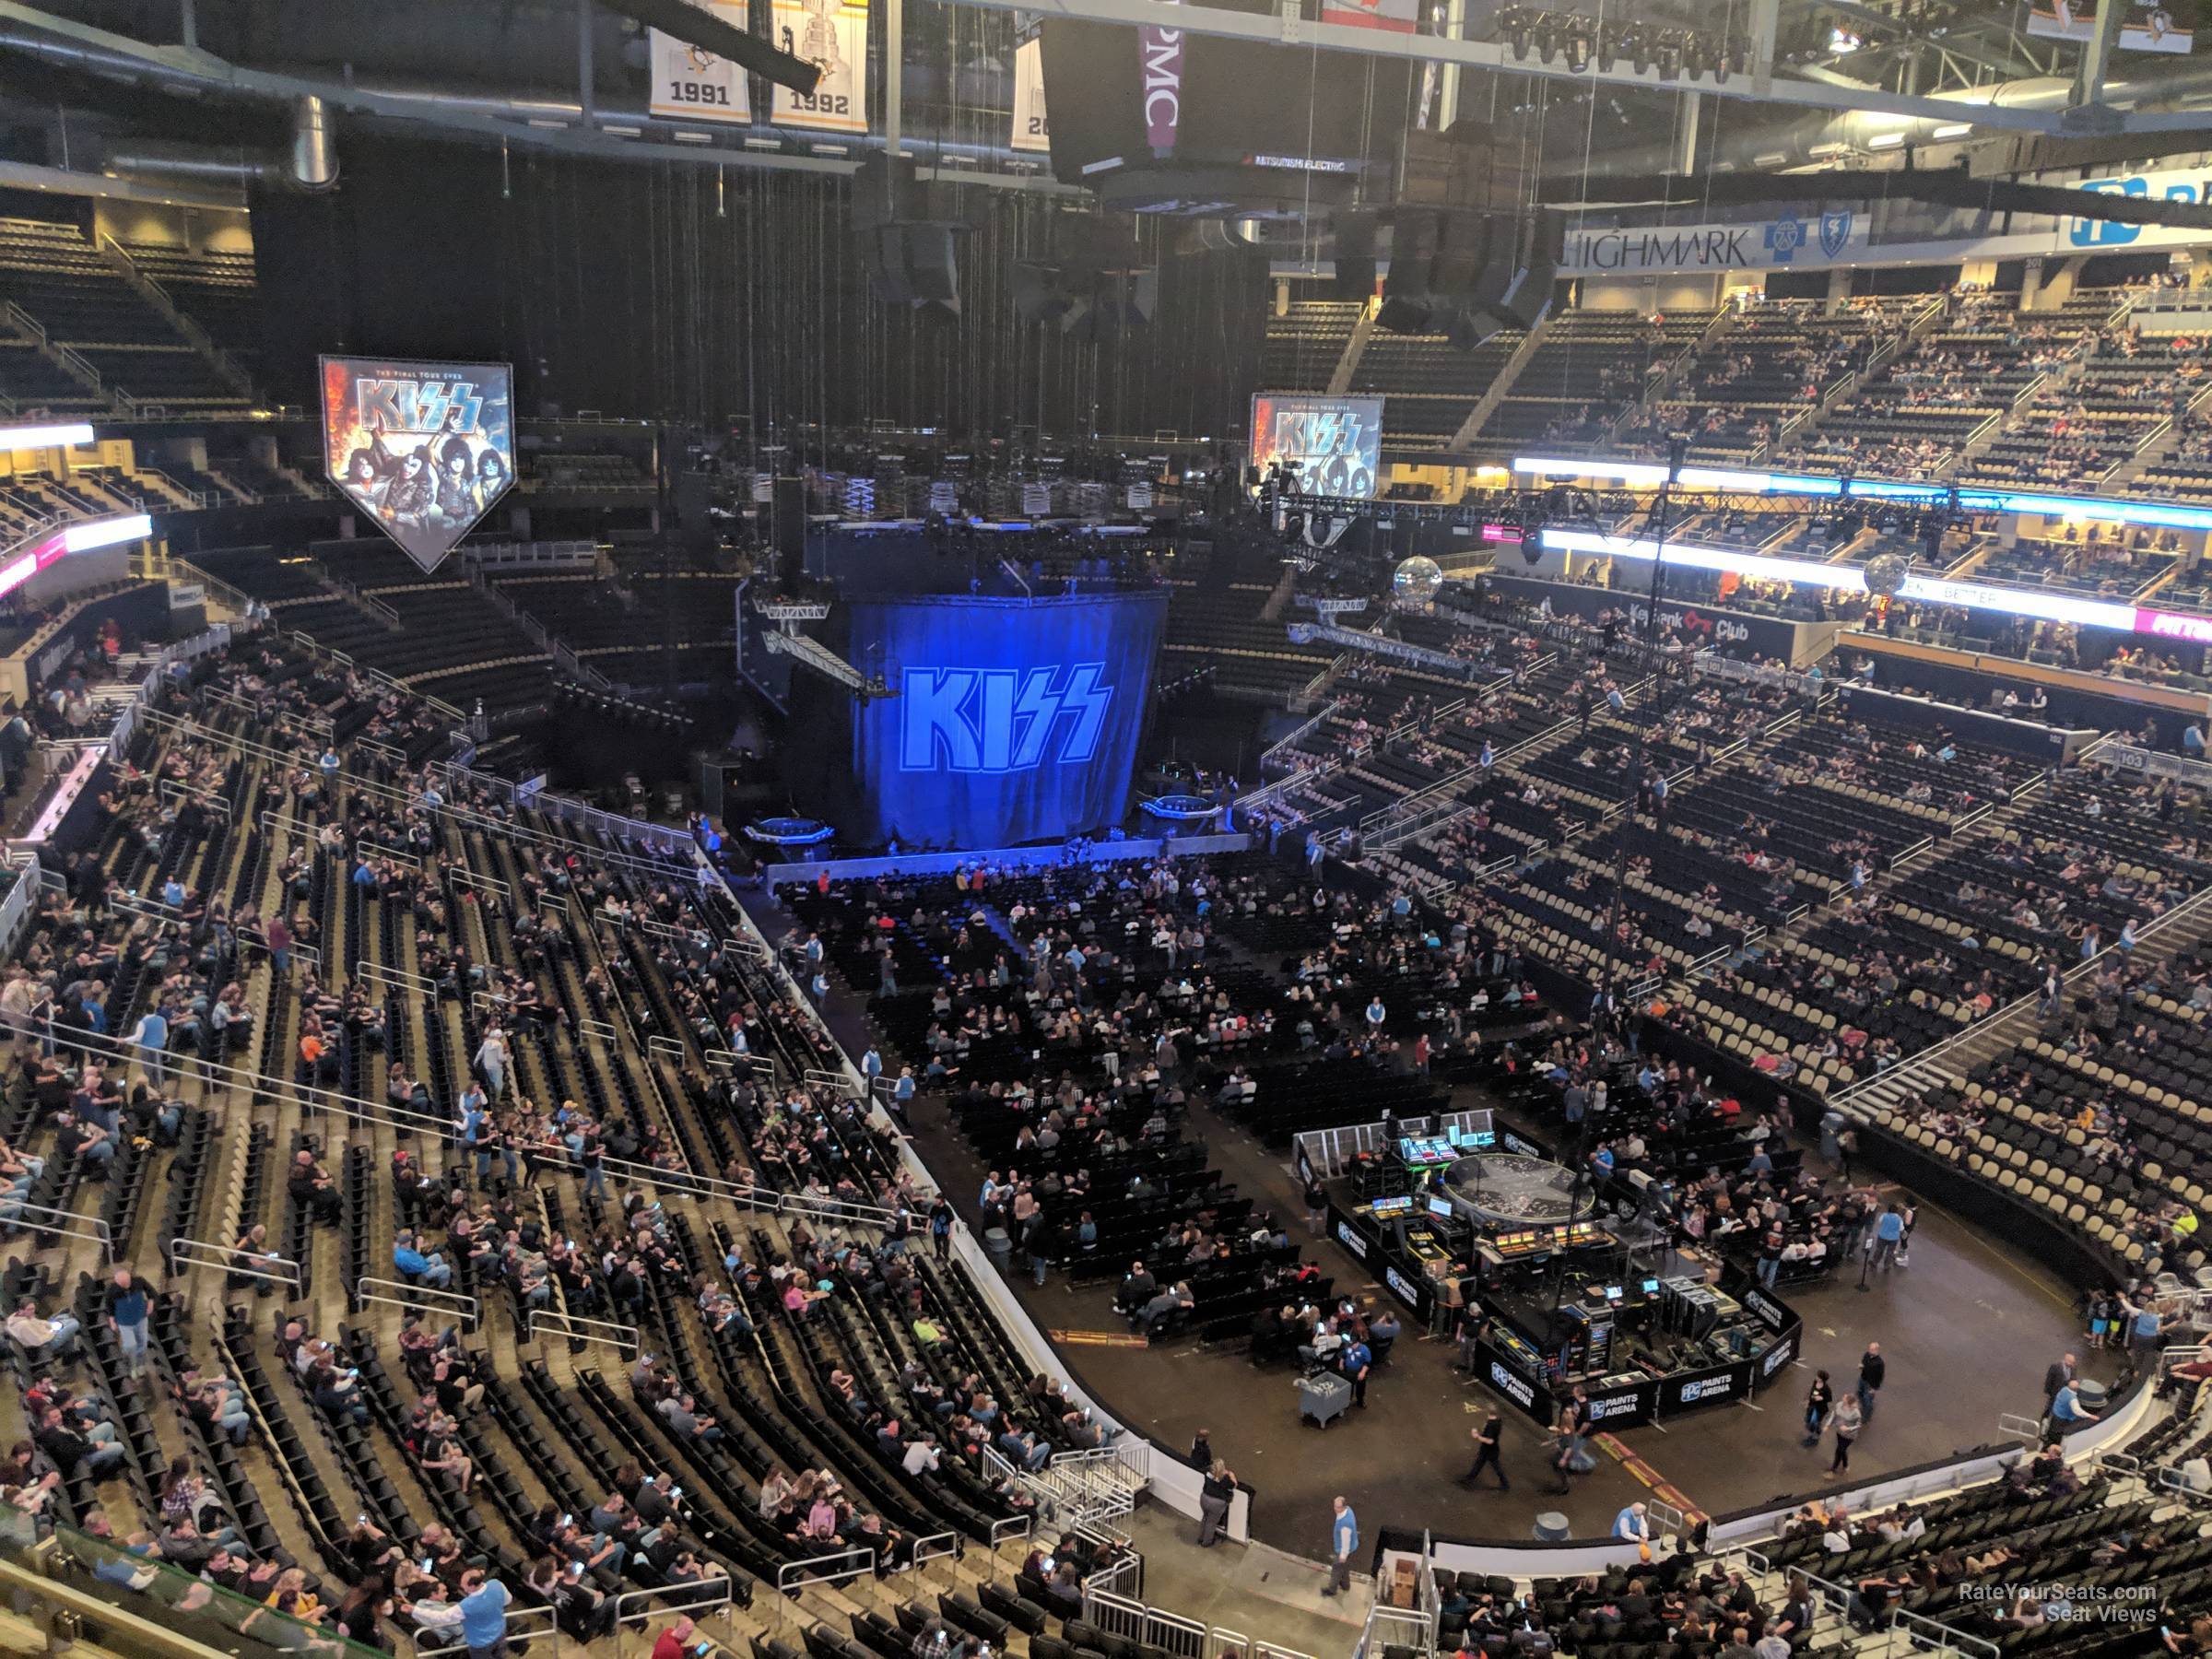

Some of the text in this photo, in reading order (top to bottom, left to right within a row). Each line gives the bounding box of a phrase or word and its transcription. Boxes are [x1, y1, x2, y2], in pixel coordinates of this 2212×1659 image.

[670, 81, 731, 106] 1991
[790, 92, 849, 115] 1992
[1255, 156, 1346, 171] MITSUBISHI ELECTRIC
[1560, 229, 1747, 269] HIGHMARK
[394, 370, 417, 378] FINAL
[357, 379, 483, 434] KISS
[1276, 412, 1362, 457] KISS
[1716, 619, 1748, 641] Club
[1709, 662, 1721, 673] 101
[900, 661, 1114, 773] KISS
[2121, 753, 2143, 768] 103
[1506, 1383, 1531, 1408] ARENA
[1508, 1373, 1535, 1398] PAINTS
[1681, 1374, 1732, 1400] PPG PAINTS
[1700, 1384, 1731, 1397] ARENA
[1605, 1404, 1637, 1417] ARENA
[1606, 1394, 1638, 1408] PAINTS
